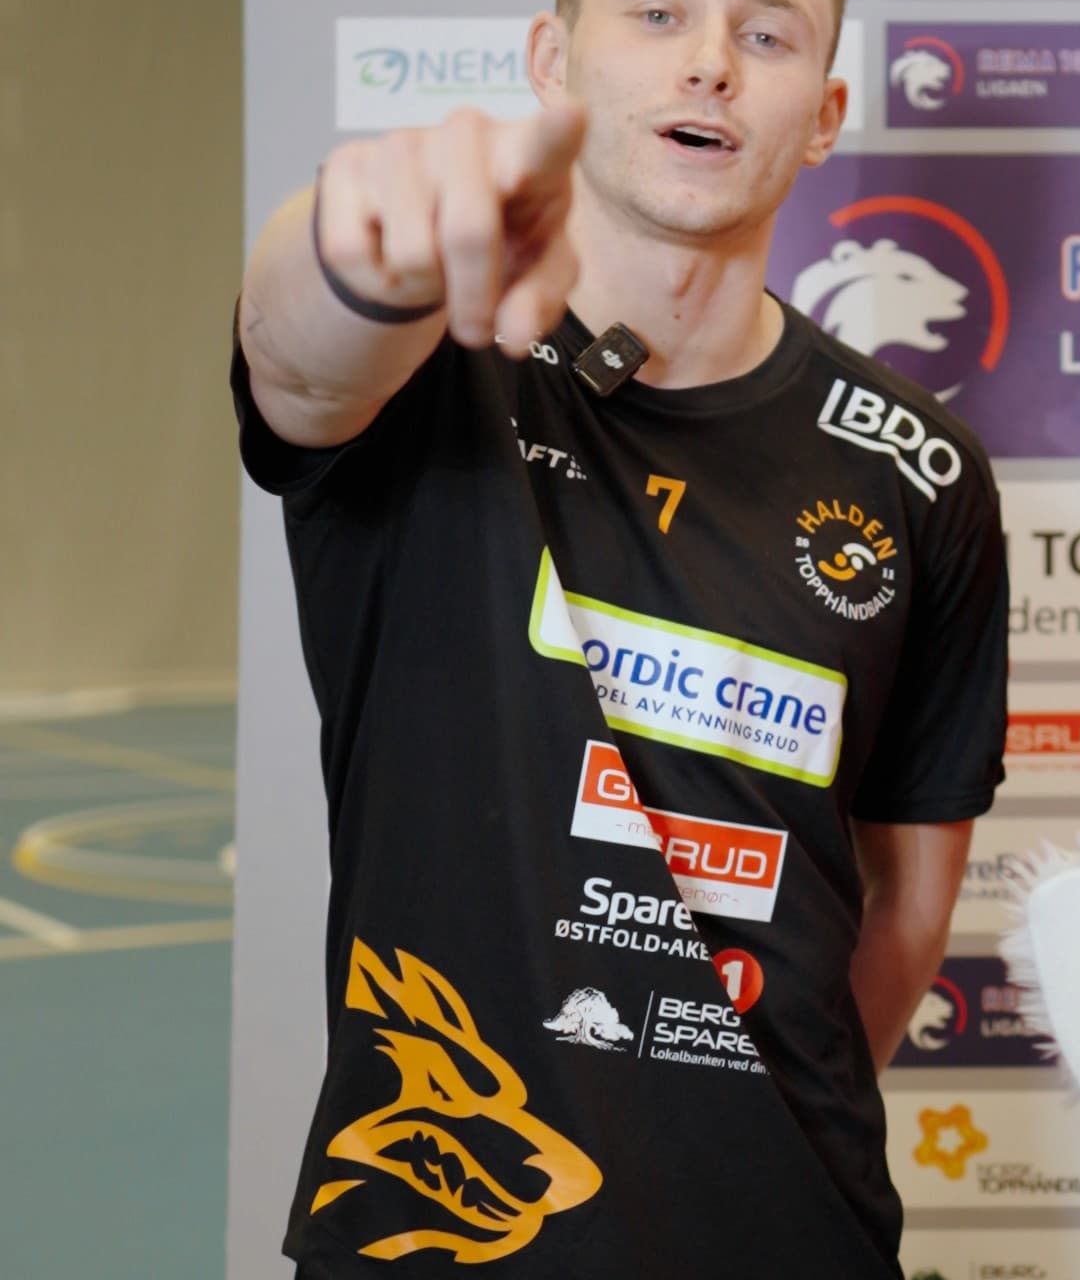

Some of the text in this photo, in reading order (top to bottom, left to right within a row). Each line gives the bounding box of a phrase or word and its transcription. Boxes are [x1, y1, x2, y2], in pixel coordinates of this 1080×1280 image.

[646, 473, 687, 535] 7
[796, 498, 898, 561] HALDEN
[794, 553, 896, 621] TOPPHÅNDBALL
[581, 639, 827, 736] ordic crane
[635, 697, 666, 714] AV
[671, 705, 800, 754] KYNNINGSRUD
[579, 877, 698, 933] Spare
[653, 1022, 760, 1057] SPARE
[657, 997, 742, 1028] BERG
[651, 1046, 726, 1069] Lokalbanken
[728, 1058, 749, 1072] ved
